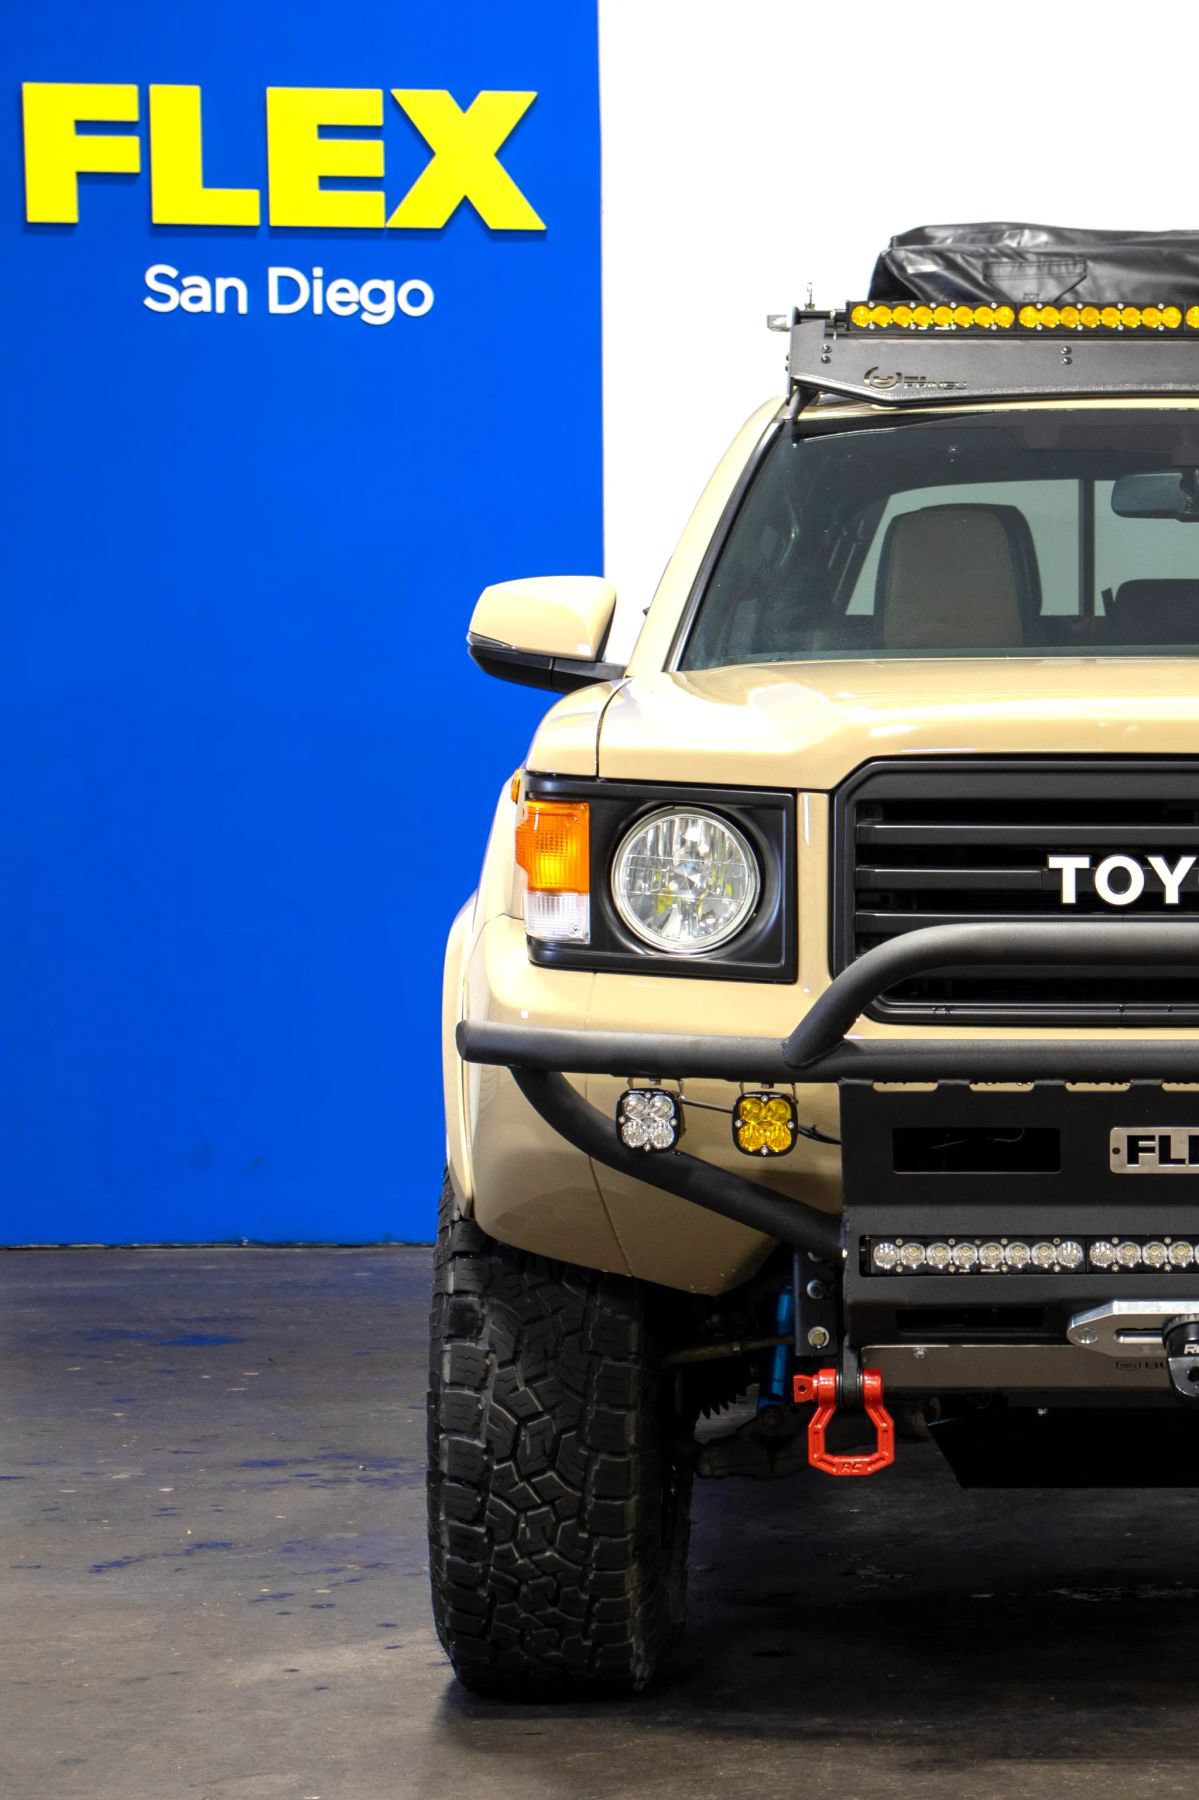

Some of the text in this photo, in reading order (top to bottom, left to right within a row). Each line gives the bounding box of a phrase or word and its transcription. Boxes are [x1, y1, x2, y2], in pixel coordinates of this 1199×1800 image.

[22, 82, 547, 231] FLEX
[144, 265, 434, 325] San Diego
